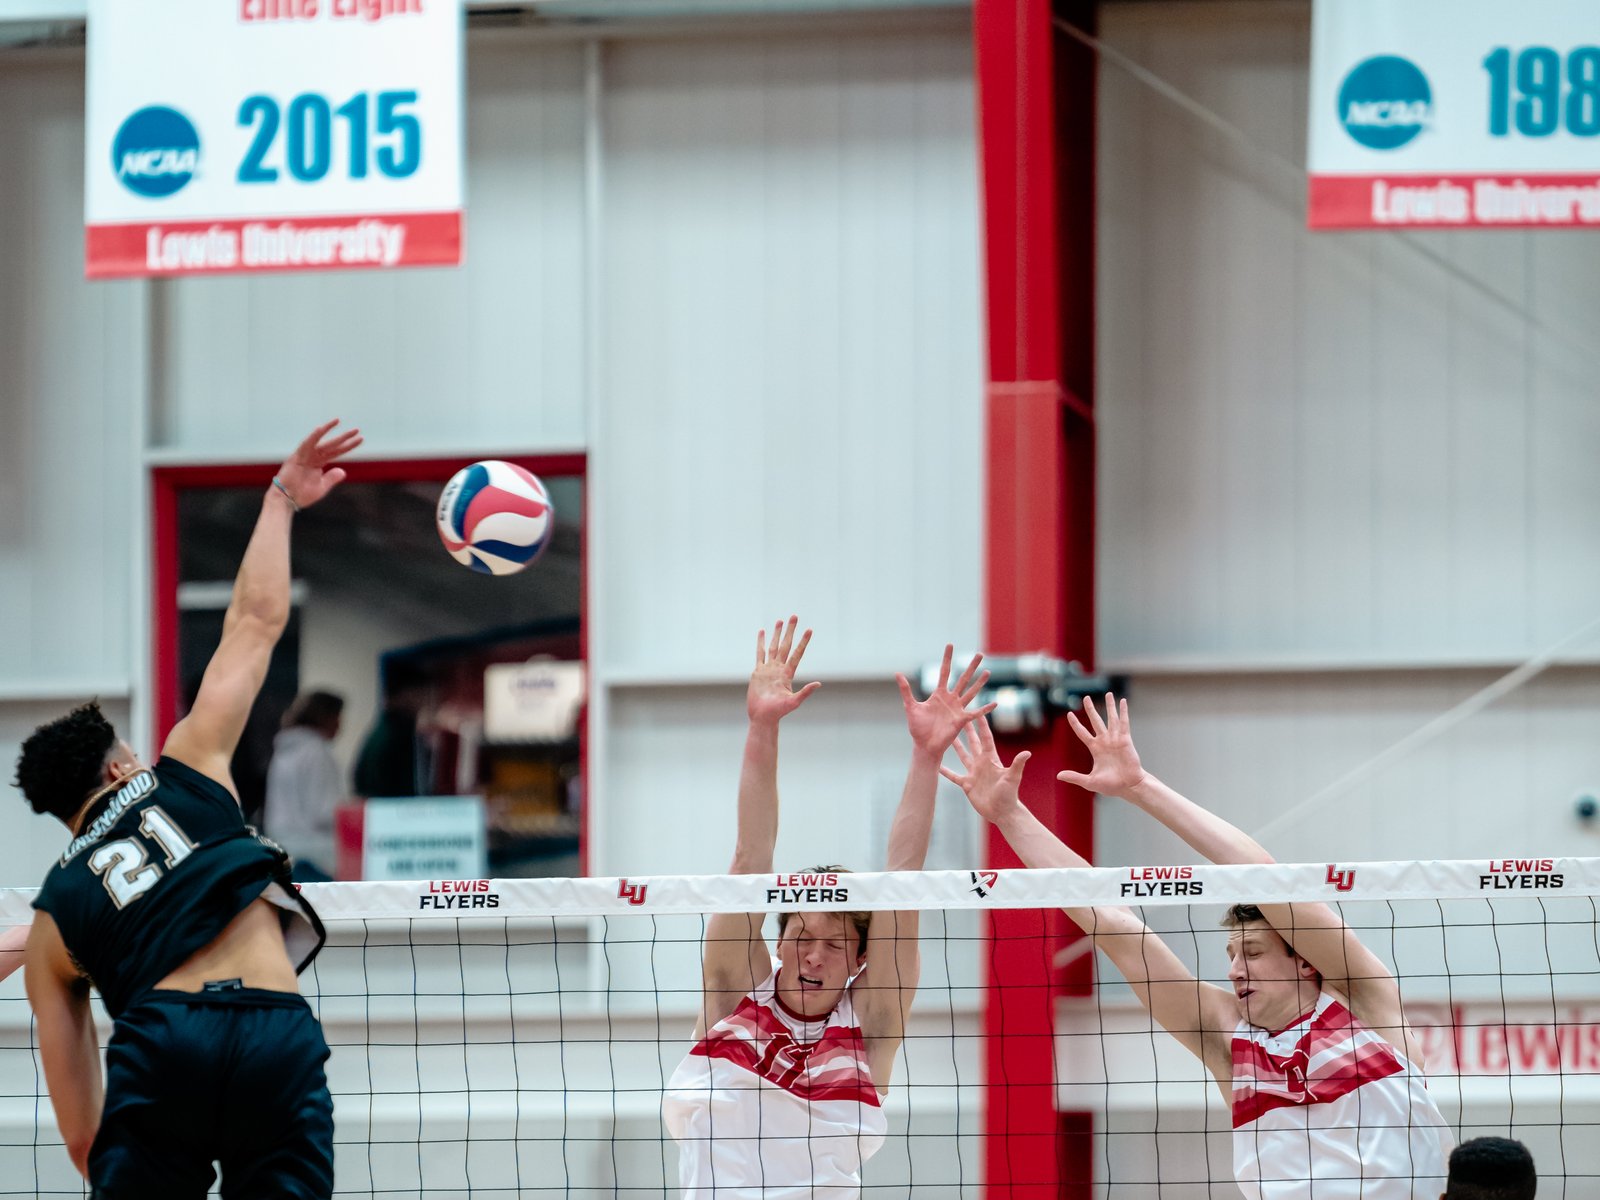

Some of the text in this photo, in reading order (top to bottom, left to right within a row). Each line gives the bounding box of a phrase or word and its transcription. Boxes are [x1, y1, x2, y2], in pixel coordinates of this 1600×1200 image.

[1346, 99, 1431, 128] NCAA
[236, 90, 421, 182] 2015
[119, 148, 199, 179] NCAA
[1372, 179, 1470, 223] Lewis
[146, 219, 405, 269] Lewis University
[88, 805, 199, 910] 21
[1489, 860, 1553, 873] LEWIS
[777, 874, 838, 887] LEWIS
[1130, 867, 1193, 880] LEWIS
[1325, 864, 1356, 892] LU
[1480, 874, 1564, 889] FLYERS
[430, 880, 490, 893] LEWIS
[617, 878, 648, 906] LU
[767, 889, 848, 903] FLYERS
[1121, 882, 1203, 897] FLYERS
[420, 895, 499, 909] FLYERS
